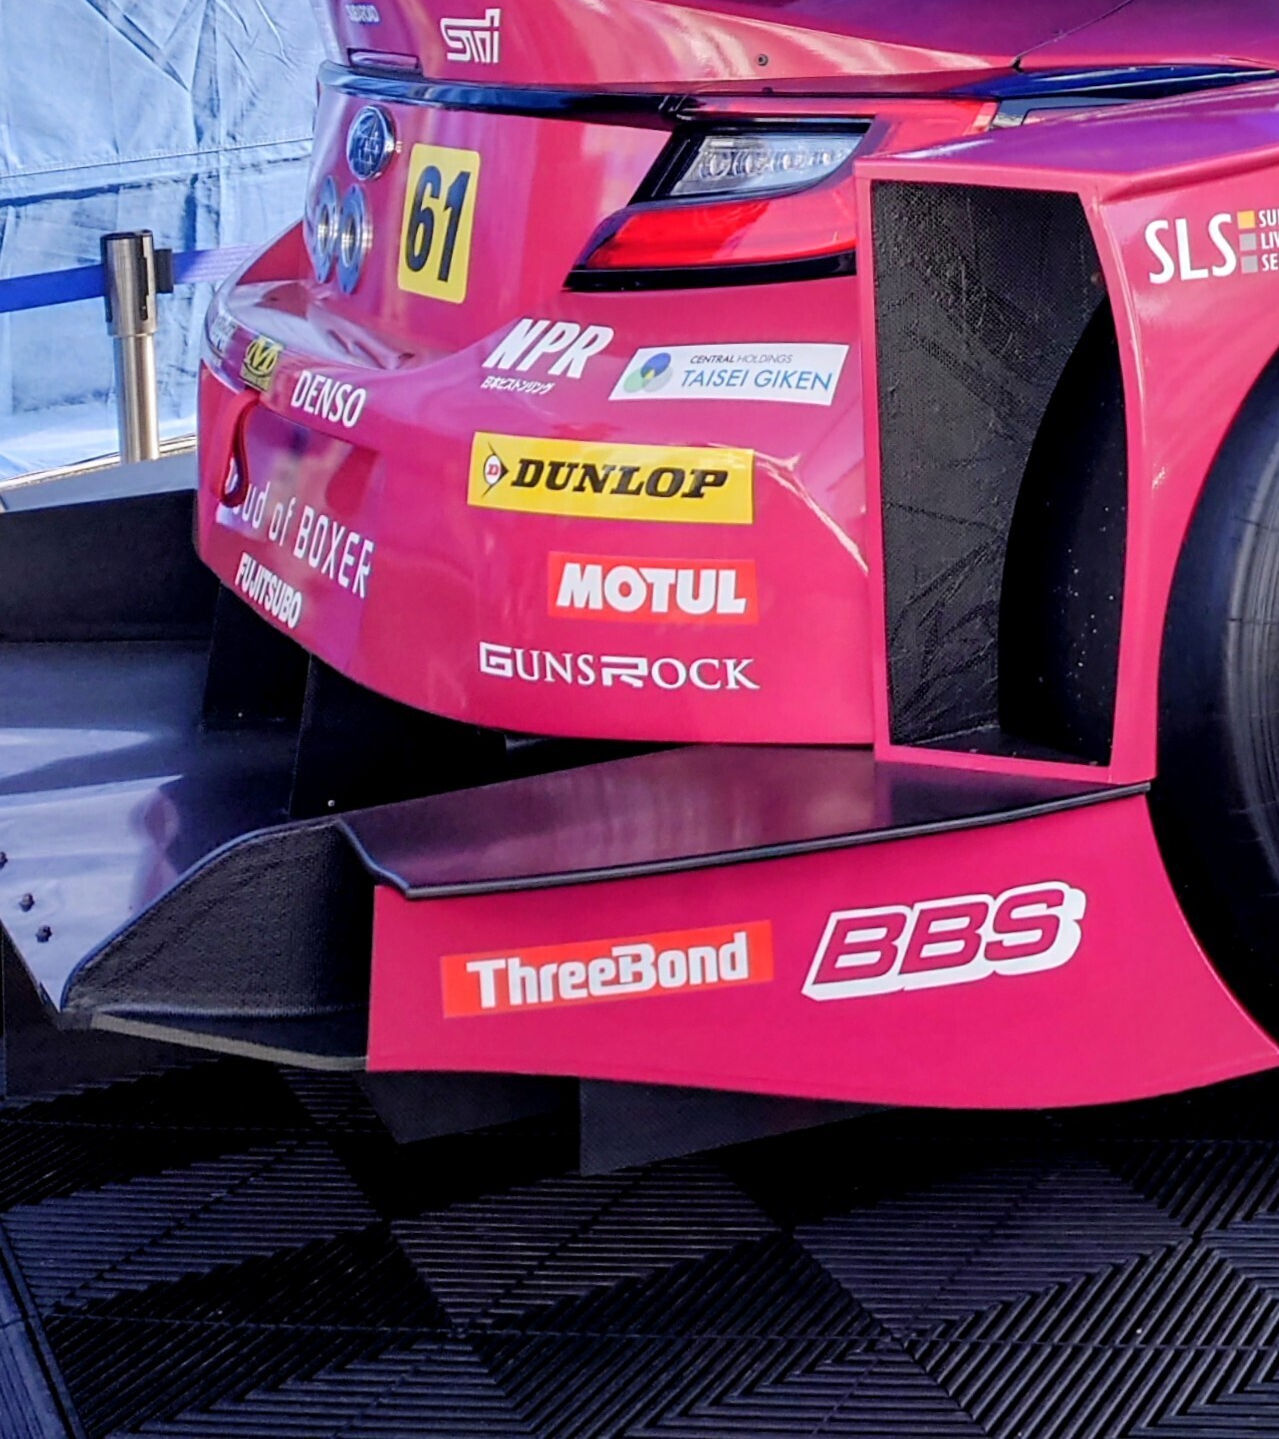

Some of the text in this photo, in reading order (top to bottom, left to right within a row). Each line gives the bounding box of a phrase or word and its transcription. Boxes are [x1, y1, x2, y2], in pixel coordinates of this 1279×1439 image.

[405, 166, 468, 282] 61
[1144, 213, 1237, 284] SLS
[482, 318, 614, 379] NPR
[681, 368, 833, 391] TAISEI GIKEN
[690, 354, 792, 364] CENTRAL HOLDINGS
[291, 370, 367, 428] DENSO
[511, 458, 728, 498] DUNLOP
[268, 497, 374, 599] of BOXER
[235, 552, 302, 629] FUJITSUBO
[556, 563, 747, 614] MOTUL
[466, 932, 749, 1009] ThreeBond
[801, 881, 1087, 1001] BBS
